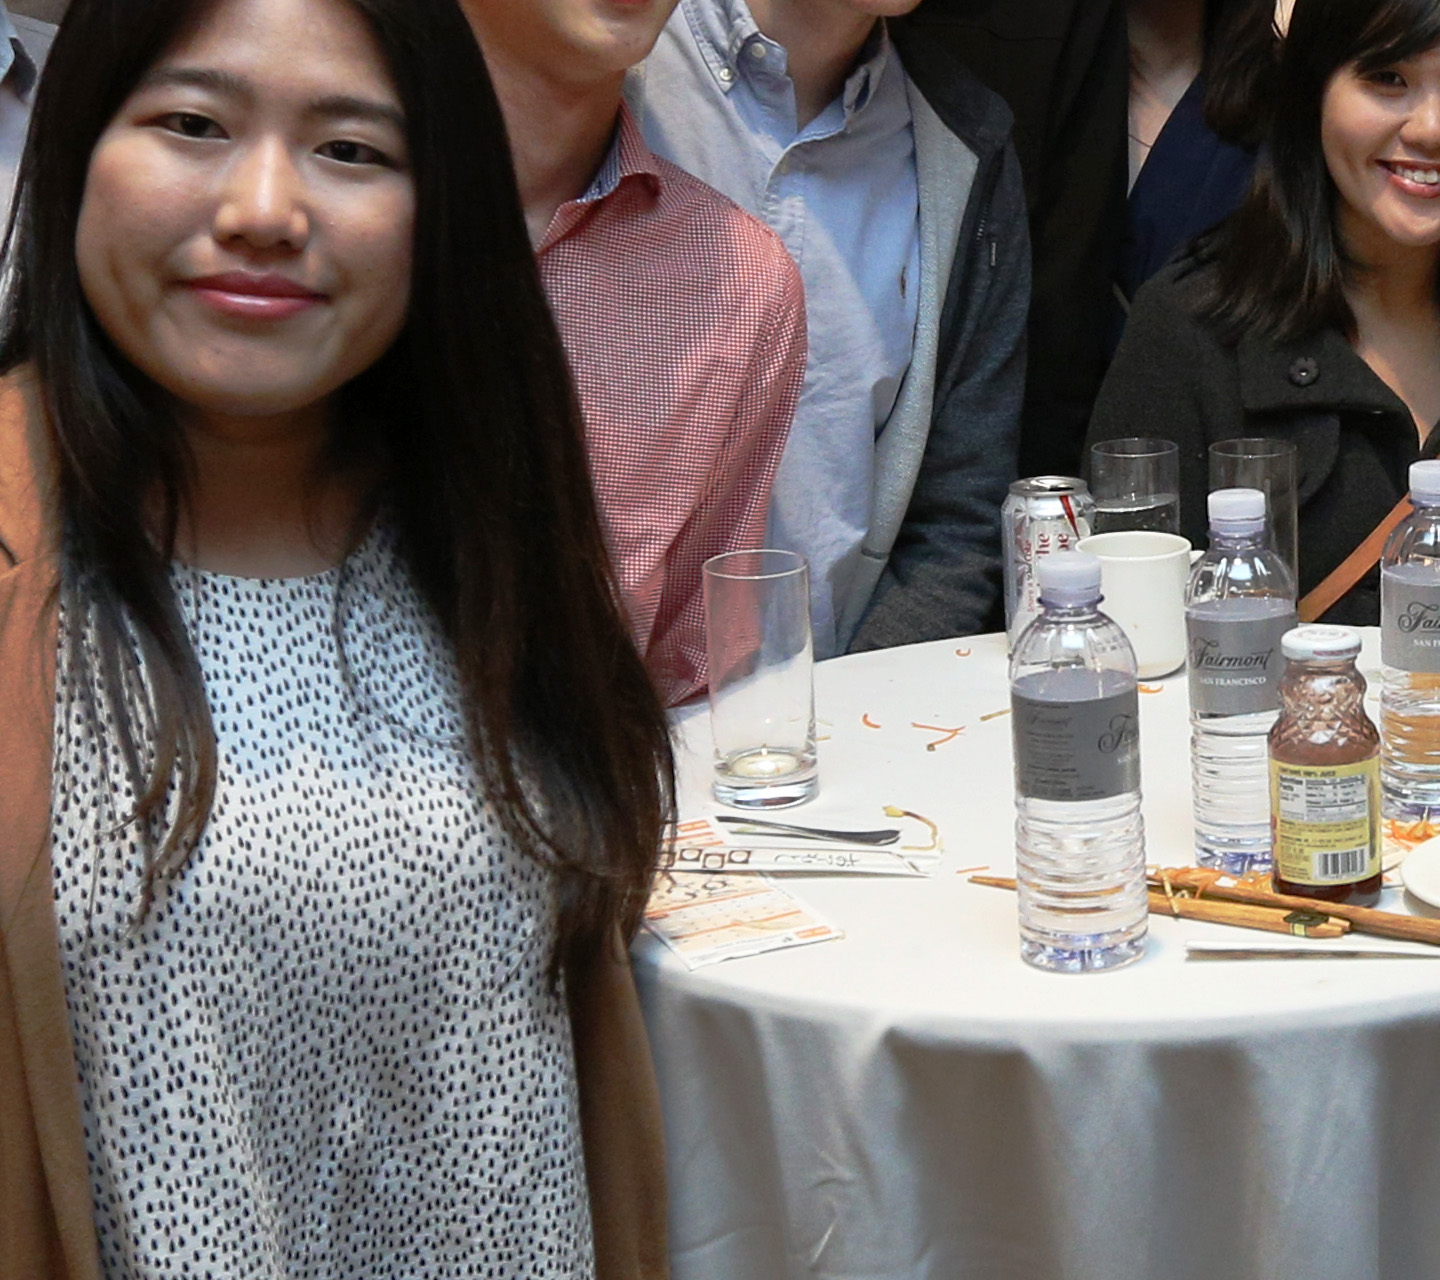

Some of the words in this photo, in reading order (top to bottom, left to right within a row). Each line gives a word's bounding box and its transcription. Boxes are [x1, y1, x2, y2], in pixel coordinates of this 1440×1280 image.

[1413, 638, 1432, 647] SAN
[1189, 636, 1274, 670] Fairmont
[1215, 676, 1267, 686] FRANCISCO
